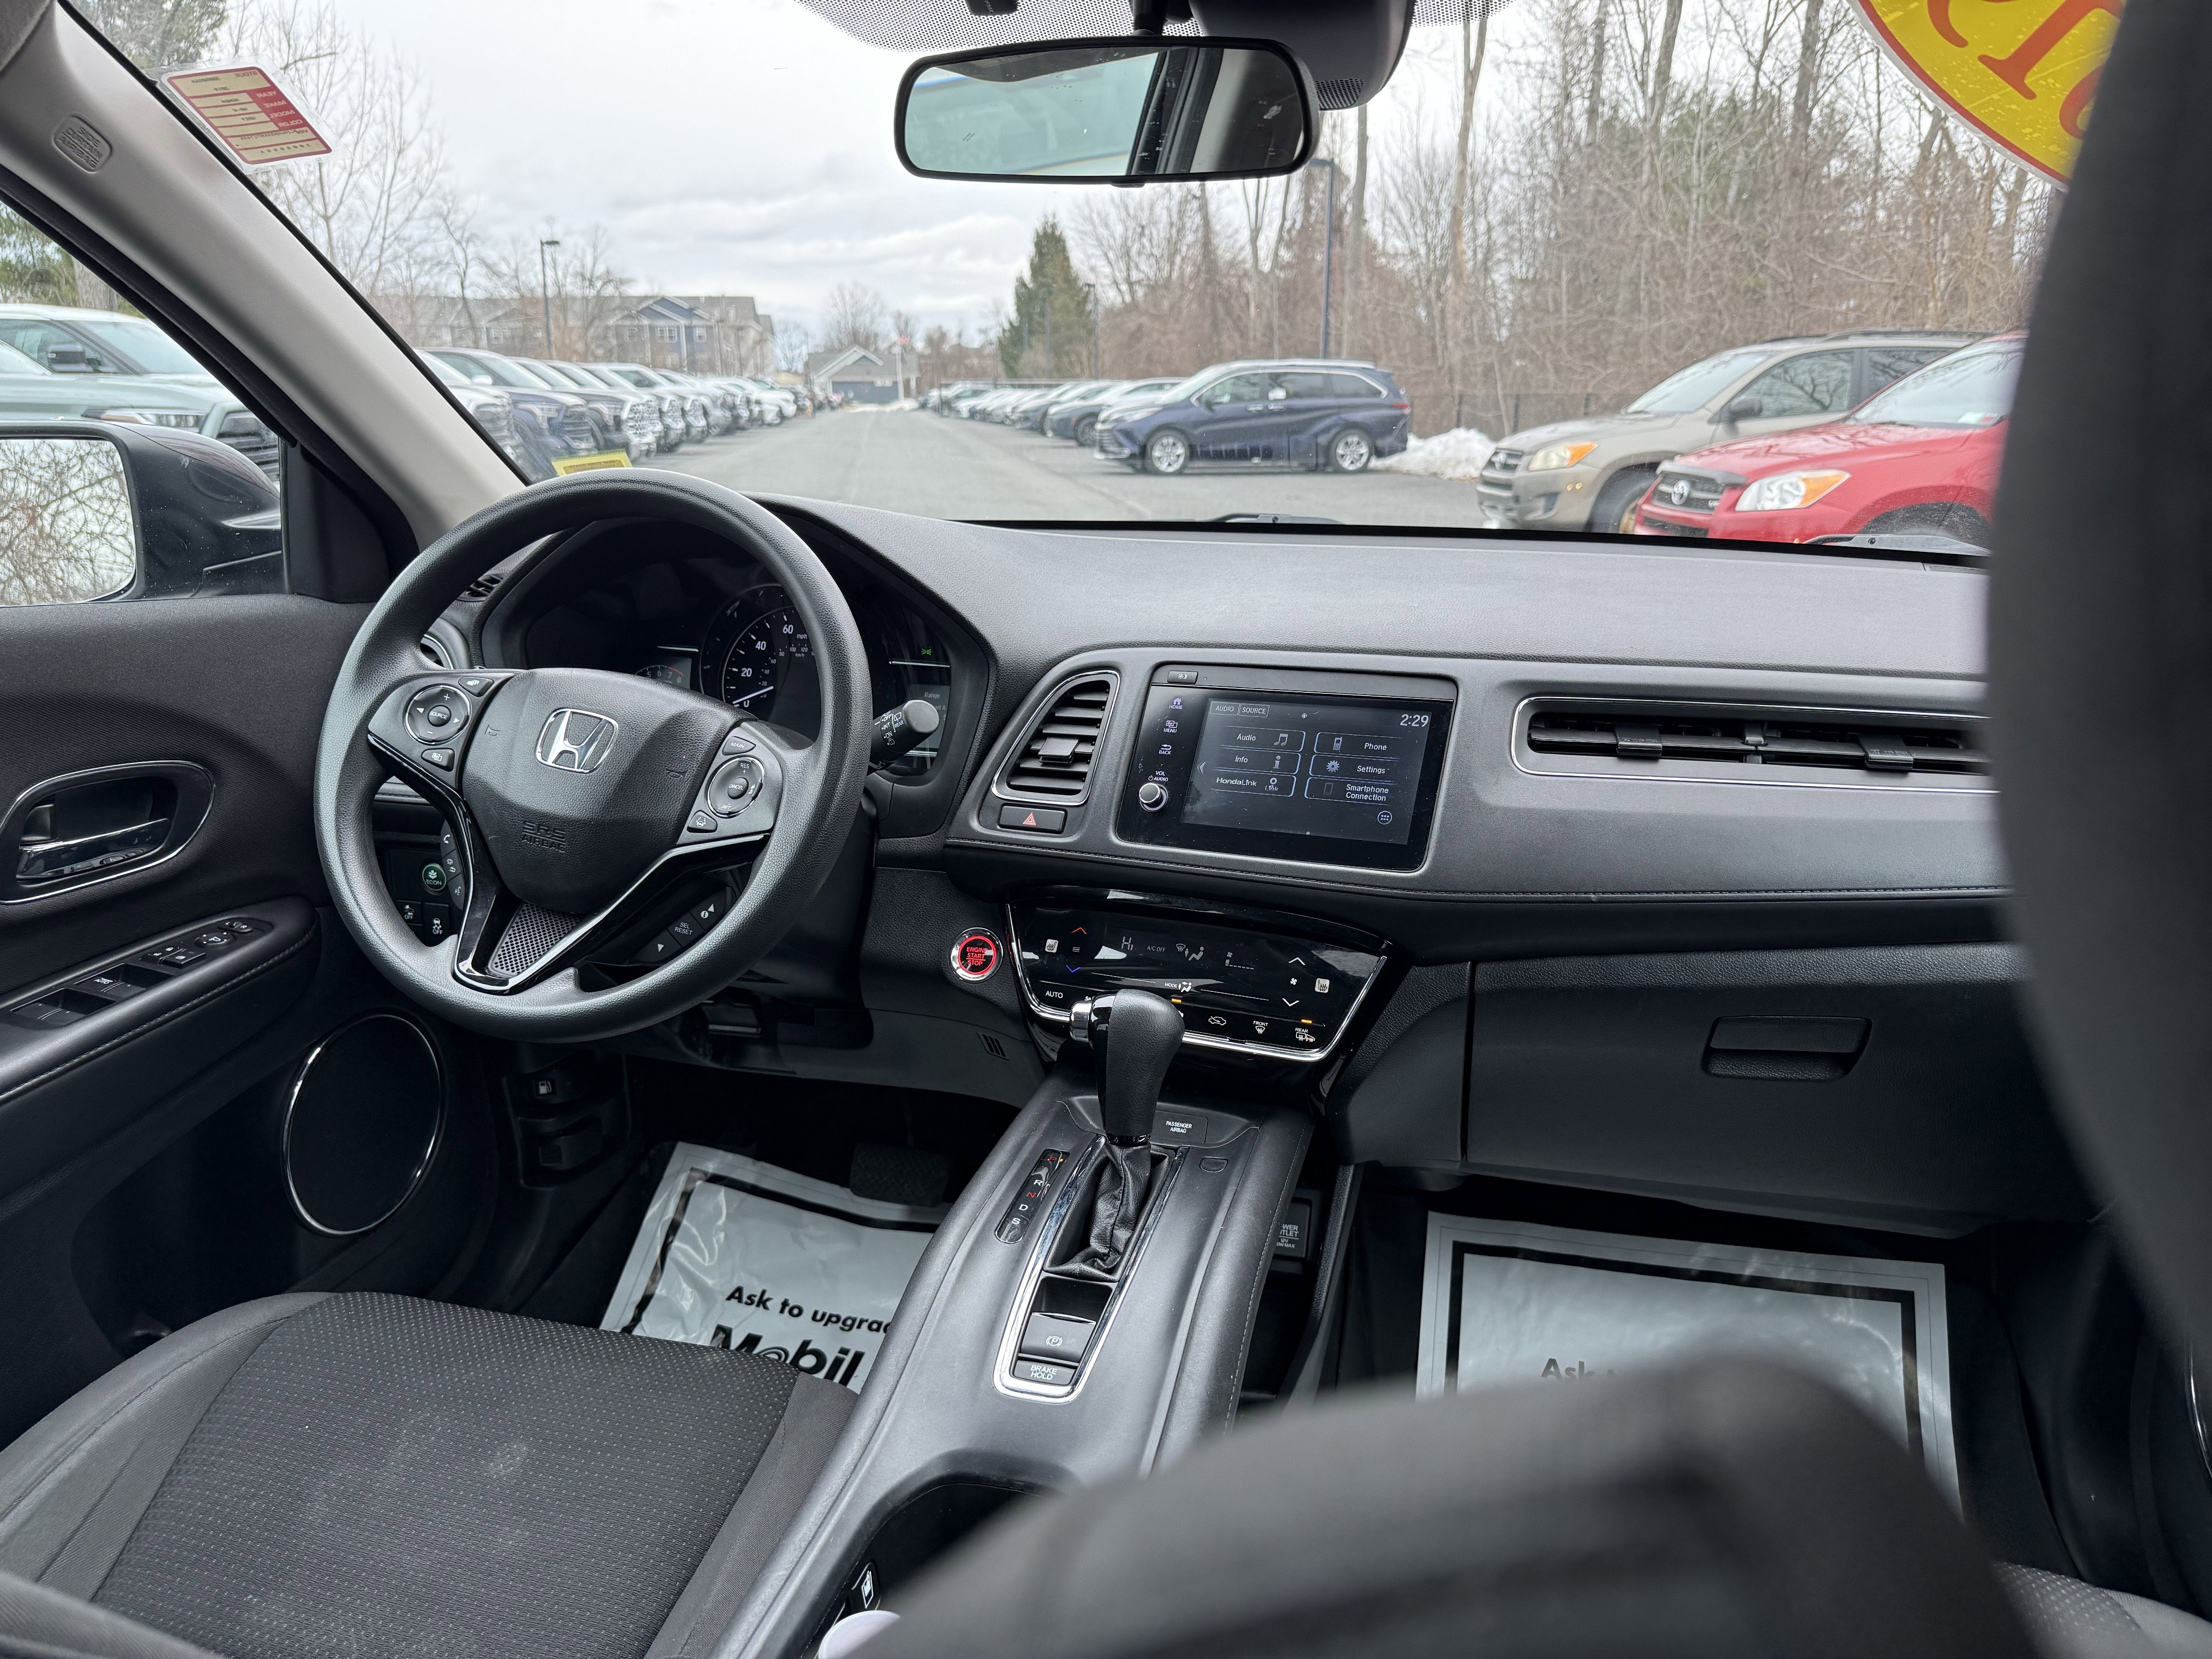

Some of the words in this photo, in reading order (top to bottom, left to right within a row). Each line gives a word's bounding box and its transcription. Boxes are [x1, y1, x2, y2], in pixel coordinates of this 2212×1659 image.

[783, 625, 793, 634] 60
[756, 641, 766, 650] 40
[741, 668, 752, 677] 20
[429, 711, 448, 720] SOURCE
[894, 720, 904, 728] REAR
[1400, 714, 1429, 727] 2:29
[885, 731, 893, 739] ON
[1357, 765, 1386, 774] Settings
[1216, 777, 1257, 787] HondaLink
[1346, 784, 1389, 793] Smartphone
[1346, 792, 1386, 801] Connection
[523, 821, 567, 841] SRS
[521, 833, 567, 853] AIRBAG
[674, 927, 693, 935] RESET
[1045, 990, 1063, 998] AUTO
[1166, 1120, 1192, 1128] PASSENGER
[1279, 1229, 1299, 1237] TLET
[726, 1285, 774, 1311] Ask
[779, 1297, 805, 1317] to
[811, 1309, 891, 1334] upgra
[1030, 1365, 1058, 1375] BRAKE
[1030, 1371, 1053, 1380] HOLD
